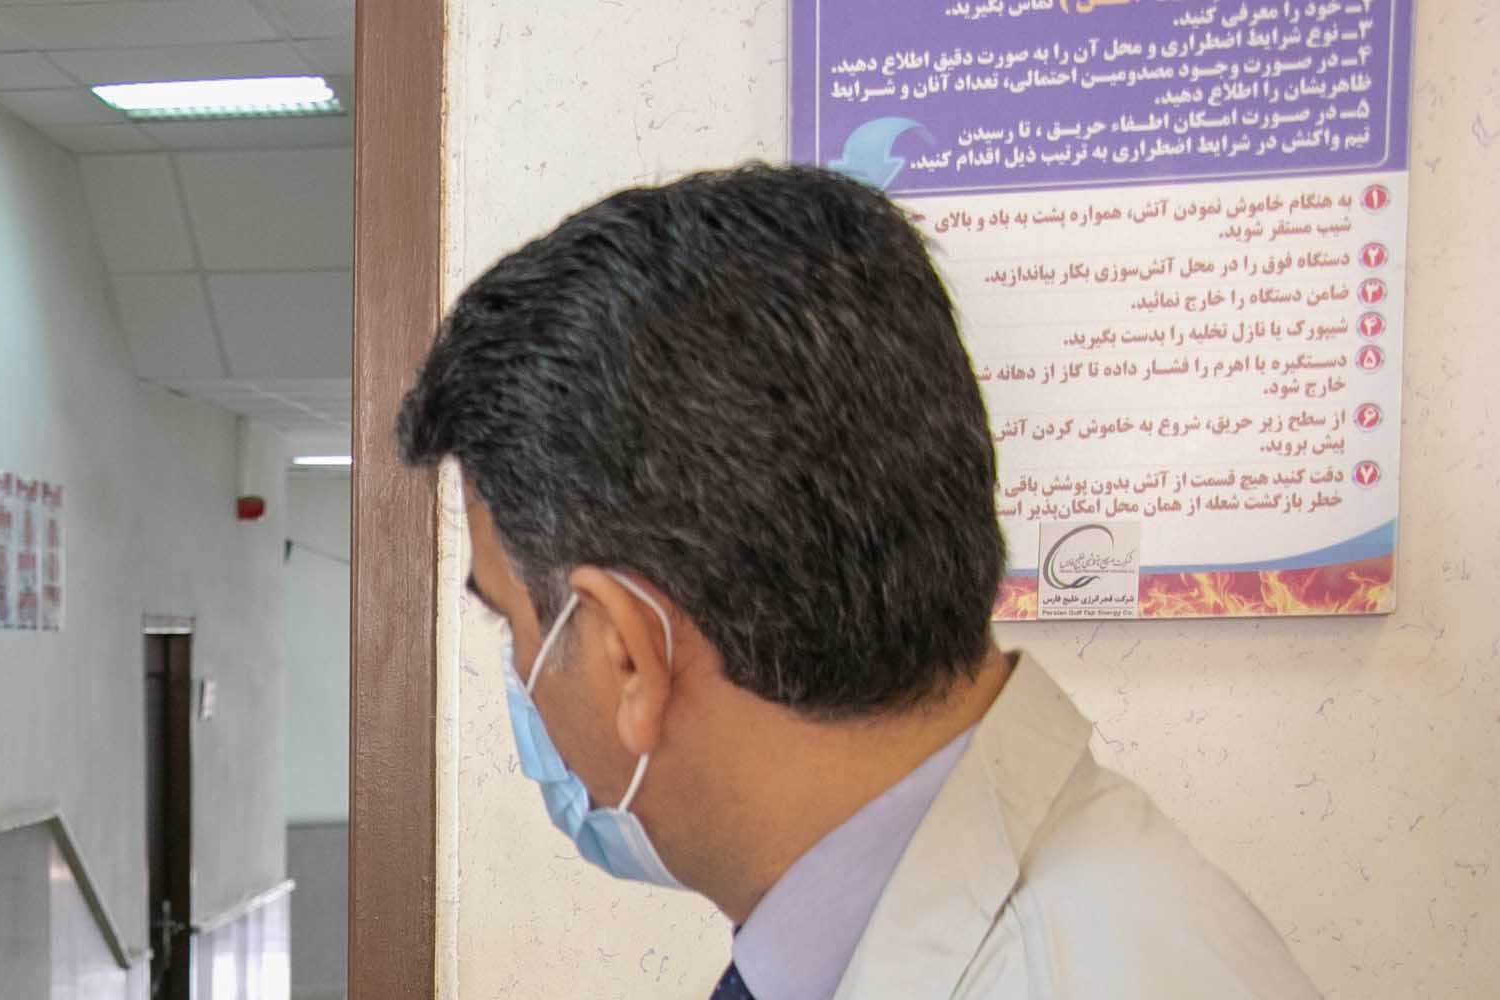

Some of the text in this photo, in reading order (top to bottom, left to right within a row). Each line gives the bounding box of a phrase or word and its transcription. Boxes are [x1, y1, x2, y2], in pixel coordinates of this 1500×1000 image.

[1221, 4, 1278, 28] معرفی
[1284, 1, 1300, 23] را
[1161, 32, 1242, 58] اضطراری
[1248, 26, 1302, 50] شرایط
[1305, 22, 1339, 48] نوع
[933, 48, 973, 72] دقیق
[977, 48, 1029, 71] صورت
[1032, 47, 1049, 65] به
[1053, 42, 1069, 65] را
[1073, 38, 1099, 63] آن
[1103, 40, 1142, 61] محل
[1146, 42, 1157, 59] و
[881, 51, 930, 76] اطلاع
[1316, 52, 1338, 74] در
[899, 85, 910, 100] و
[912, 73, 950, 99] آنان
[954, 72, 1000, 92] تعداد
[1263, 79, 1279, 104] را
[1283, 73, 1373, 101] ظاهریشان
[1207, 80, 1259, 107] اطلاع
[1315, 104, 1337, 127] در
[958, 125, 1015, 147] رسیدن
[1018, 119, 1031, 140] تا
[1281, 127, 1341, 154] واکنش
[1344, 125, 1371, 150] تیم
[1041, 145, 1088, 168] ترتیب
[1091, 146, 1108, 164] به
[1112, 136, 1192, 164] اضطراری
[1197, 133, 1251, 158] شرایط
[1255, 137, 1277, 156] در
[955, 148, 1000, 173] اقدام
[1004, 146, 1036, 169] ذیل
[1173, 201, 1222, 222] نمودن
[1226, 194, 1284, 220] خاموش
[1289, 194, 1333, 215] هنگام
[1337, 195, 1353, 213] به
[934, 210, 972, 234] بالای
[988, 208, 1010, 230] باد
[1014, 212, 1028, 230] به
[1032, 206, 1066, 229] پشت
[1069, 205, 1122, 227] همواره
[1269, 219, 1312, 242] مستقر
[1180, 258, 1214, 278] محل
[1219, 259, 1238, 278] در
[1243, 255, 1258, 276] را
[1261, 254, 1293, 275] فوق
[1297, 251, 1350, 268] دستگاه
[1059, 263, 1090, 285] بکار
[1184, 290, 1225, 312] خارج
[1231, 290, 1246, 310] را
[1249, 287, 1302, 304] دستگاه
[1306, 284, 1349, 307] ضامن
[1120, 329, 1165, 347] بدست
[1170, 325, 1184, 346] را
[1188, 324, 1228, 344] تخلیه
[1232, 321, 1266, 343] نازل
[996, 363, 1036, 381] دهانه
[1041, 363, 1055, 385] از
[1087, 362, 1099, 378] تا
[1102, 361, 1138, 378] داده
[1194, 358, 1209, 378] را
[1213, 356, 1250, 377] اهرم
[1270, 353, 1348, 374] دستگیره
[1304, 375, 1346, 398] خارج
[1031, 418, 1075, 441] کردن
[1078, 416, 1134, 439] خاموش
[1139, 418, 1153, 437] به
[1157, 415, 1201, 437] شروع
[1287, 411, 1327, 432] سطح
[1332, 409, 1346, 431] از
[1311, 434, 1346, 454] پیش
[1090, 475, 1130, 495] بدون
[1133, 470, 1171, 494] آتش
[1172, 471, 1187, 493] از
[1190, 469, 1236, 488] قسمت
[1239, 473, 1269, 490] هیچ
[1272, 468, 1307, 487] کنید
[1309, 465, 1344, 483] دقت
[1004, 474, 1038, 498] باقی
[1104, 497, 1139, 517] محل
[1142, 496, 1182, 517] همان
[1186, 496, 1201, 516] از
[1204, 493, 1240, 511] شعله
[1307, 489, 1343, 512] خطر
